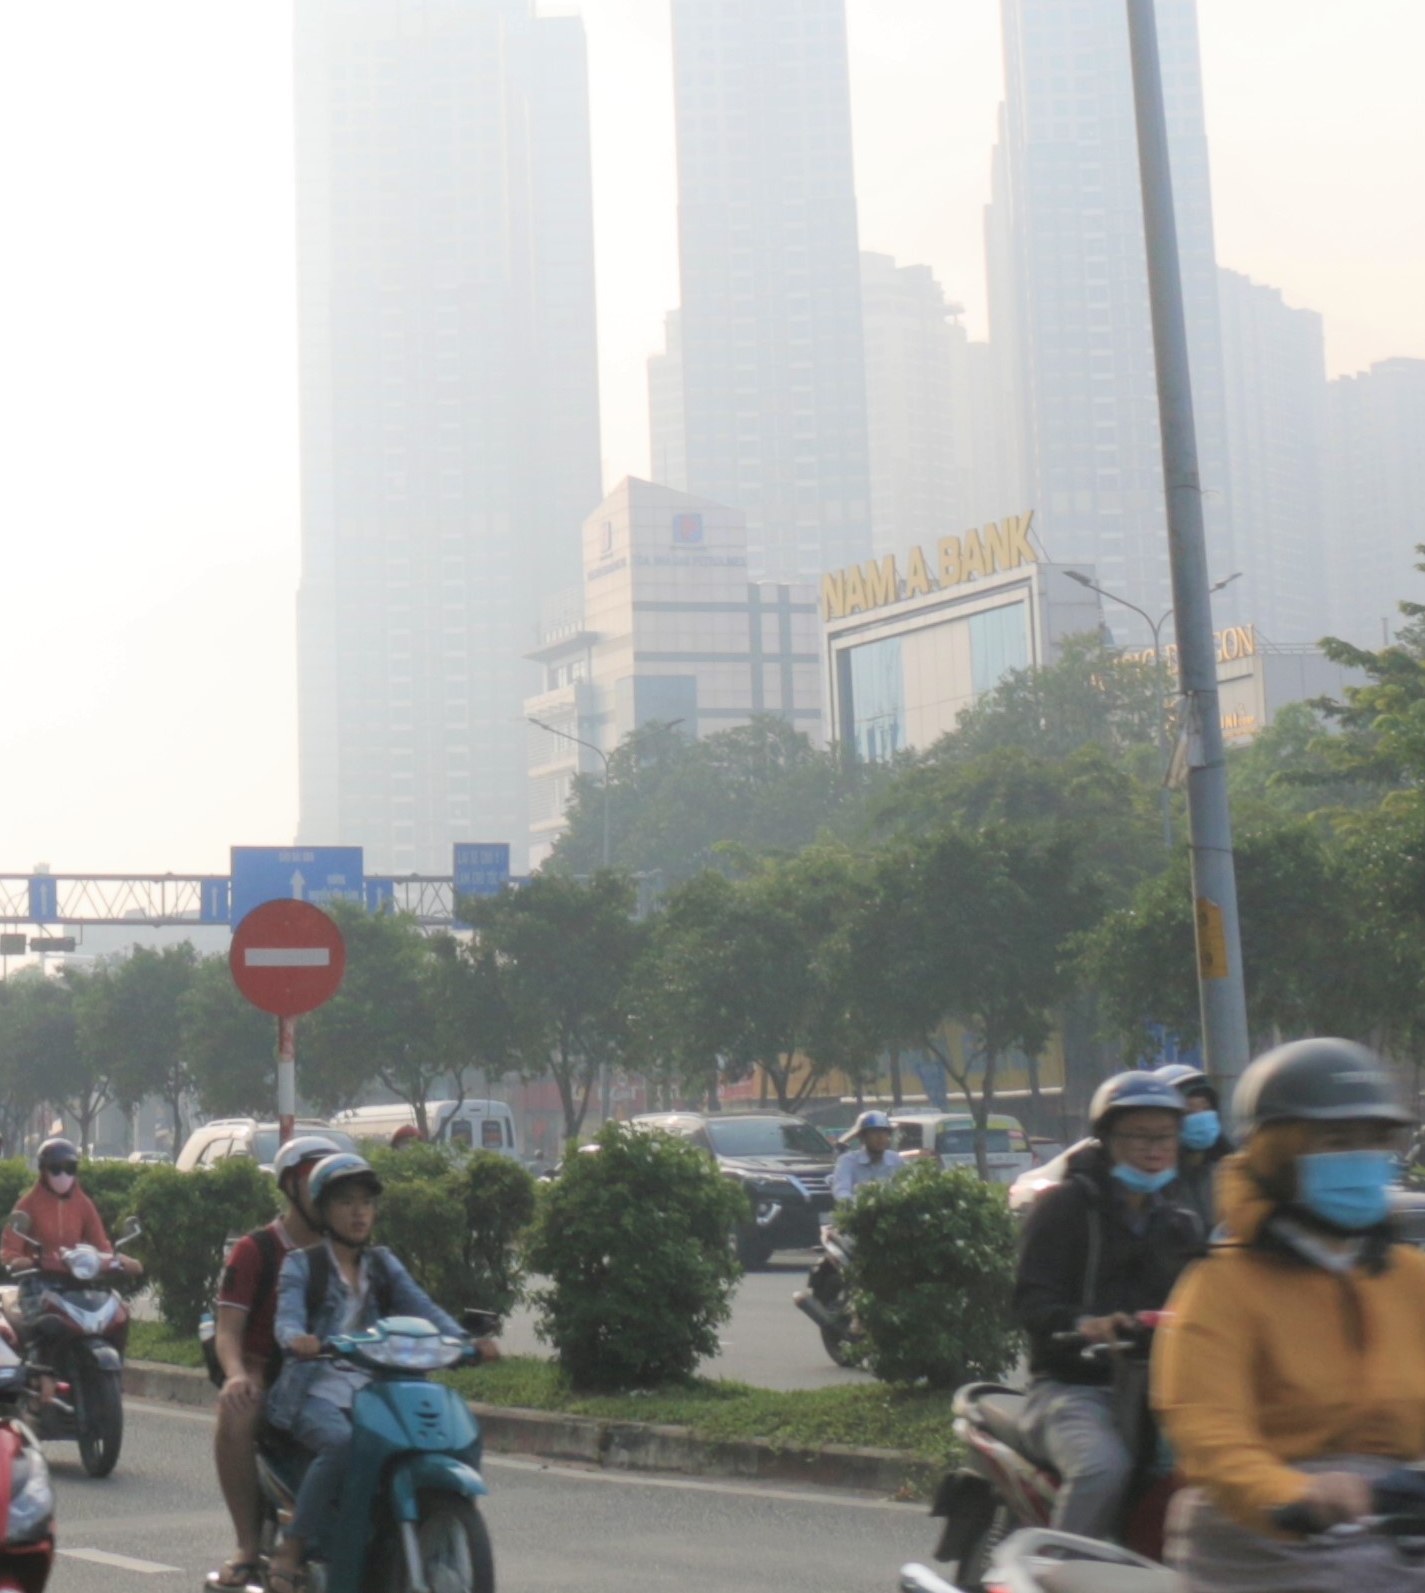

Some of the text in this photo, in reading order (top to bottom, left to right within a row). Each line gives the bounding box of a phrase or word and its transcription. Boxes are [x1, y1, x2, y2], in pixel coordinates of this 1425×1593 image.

[822, 509, 1038, 622] NAM A BANK
